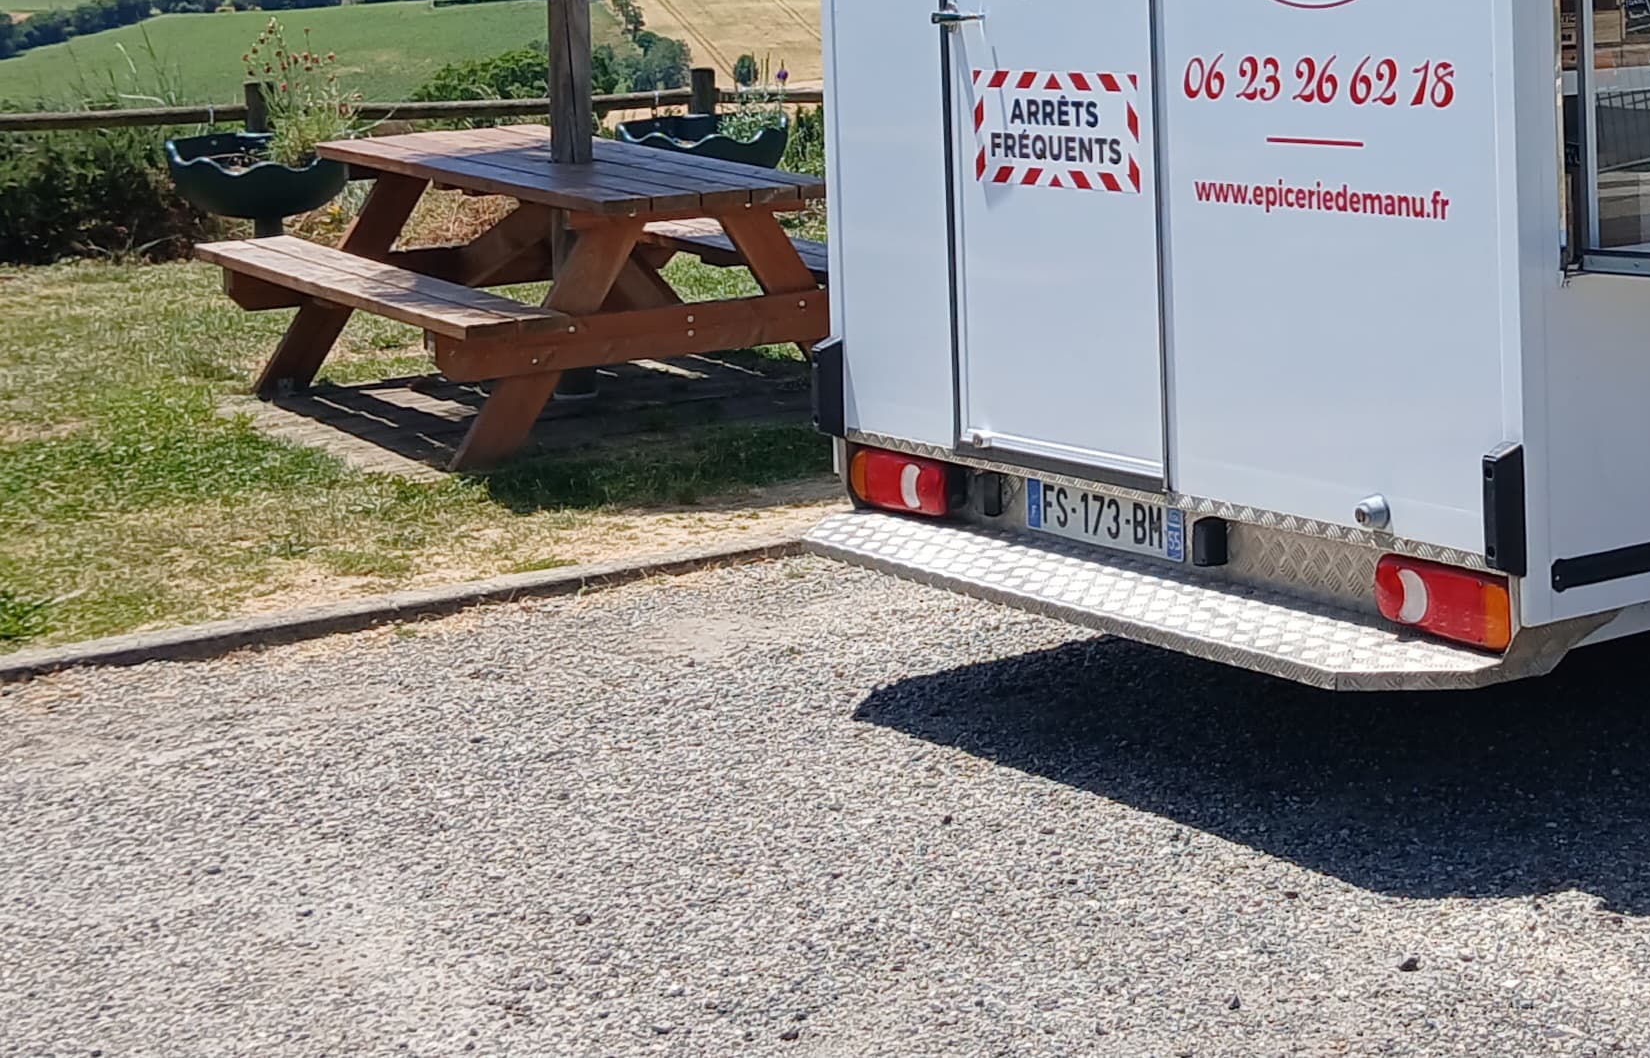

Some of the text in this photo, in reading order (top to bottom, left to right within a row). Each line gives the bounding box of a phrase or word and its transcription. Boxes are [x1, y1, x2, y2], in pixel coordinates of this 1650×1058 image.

[1183, 53, 1456, 110] 06 23 26 62 18
[1010, 94, 1099, 128] ARRÊTS
[990, 130, 1122, 166] FRÉQUENTS
[1195, 180, 1449, 220] www.epiceriedemanu.fr
[1042, 483, 1163, 549] FS-173-BM
